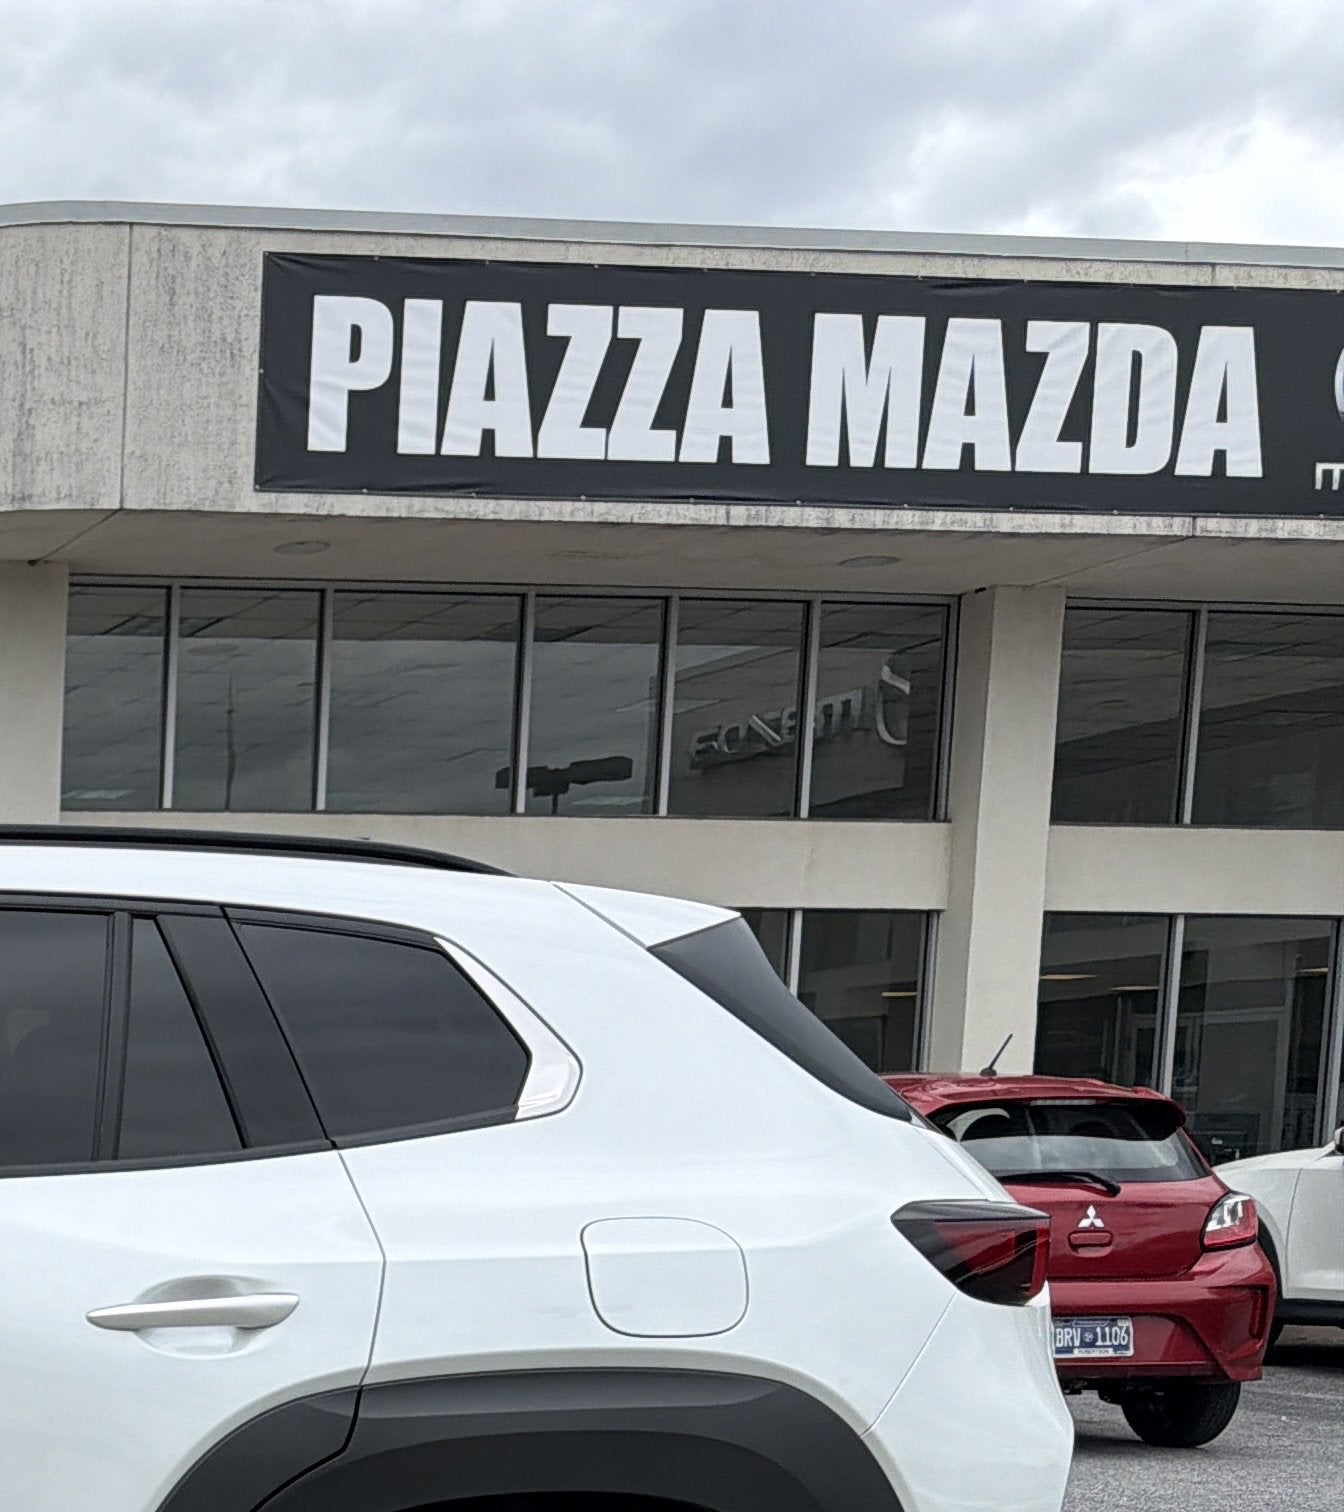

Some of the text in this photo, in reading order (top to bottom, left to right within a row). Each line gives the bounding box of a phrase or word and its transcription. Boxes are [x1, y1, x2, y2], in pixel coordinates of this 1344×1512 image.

[306, 294, 1264, 479] PIAZZA MAZDA
[1055, 1326, 1129, 1348] BRV 1106
